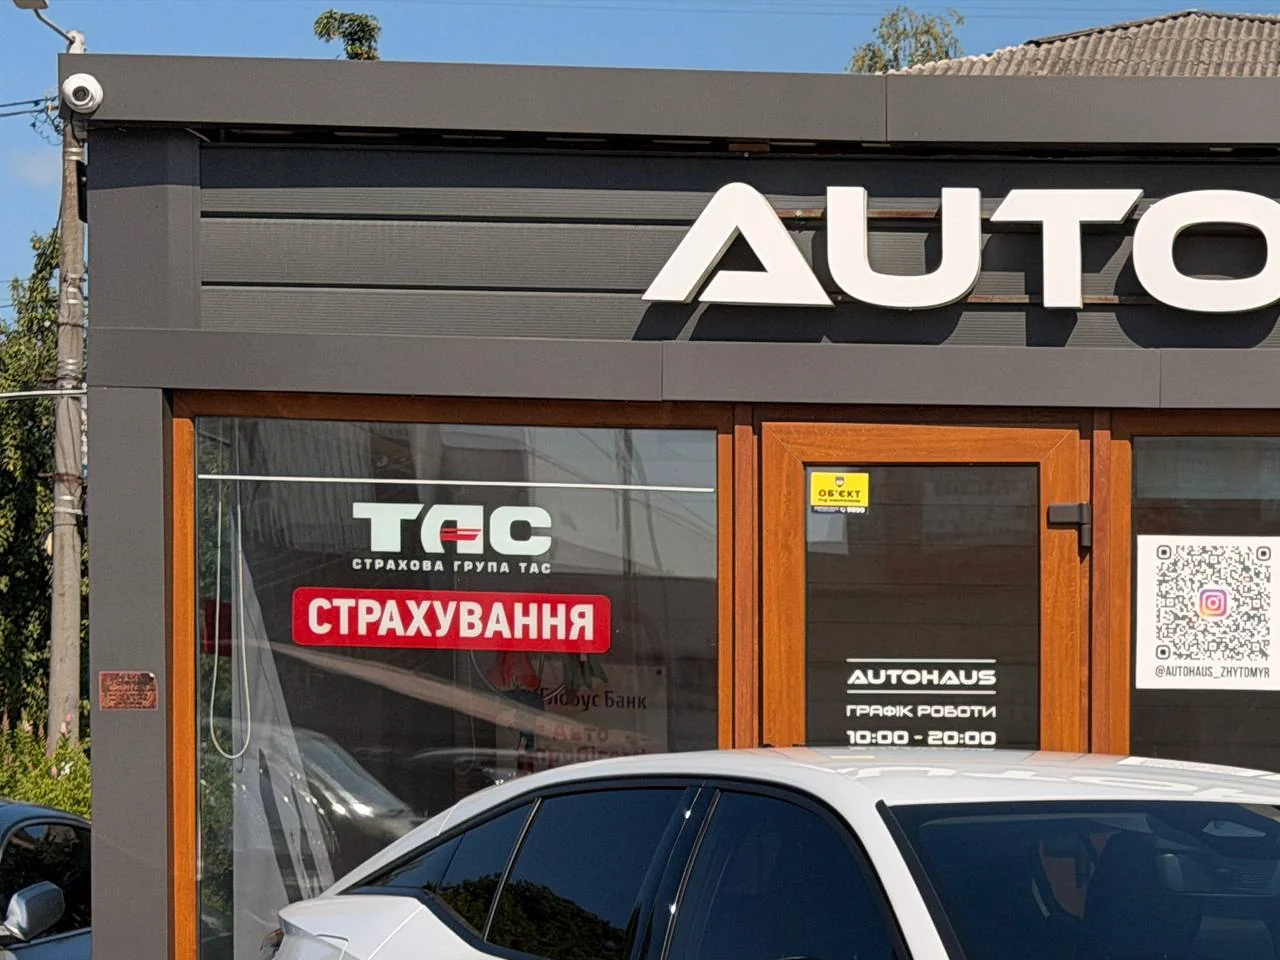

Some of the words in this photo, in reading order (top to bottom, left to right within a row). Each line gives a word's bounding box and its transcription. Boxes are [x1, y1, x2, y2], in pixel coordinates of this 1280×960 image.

[353, 502, 552, 555] ТАС
[352, 559, 444, 572] СТРАХОВА
[453, 560, 510, 573] ГРУПА
[519, 562, 551, 574] ТАС
[308, 597, 594, 641] СТРАХУВАННЯ
[846, 669, 997, 685] AUTOHAUS
[1155, 665, 1270, 679] @AUTOHAUS_ZHYTOMYR
[604, 690, 647, 709] Банк
[846, 705, 914, 717] ГРАФІК
[917, 705, 996, 718] РОБОТИ
[846, 730, 909, 744] 10:00
[927, 731, 996, 745] 20:00
